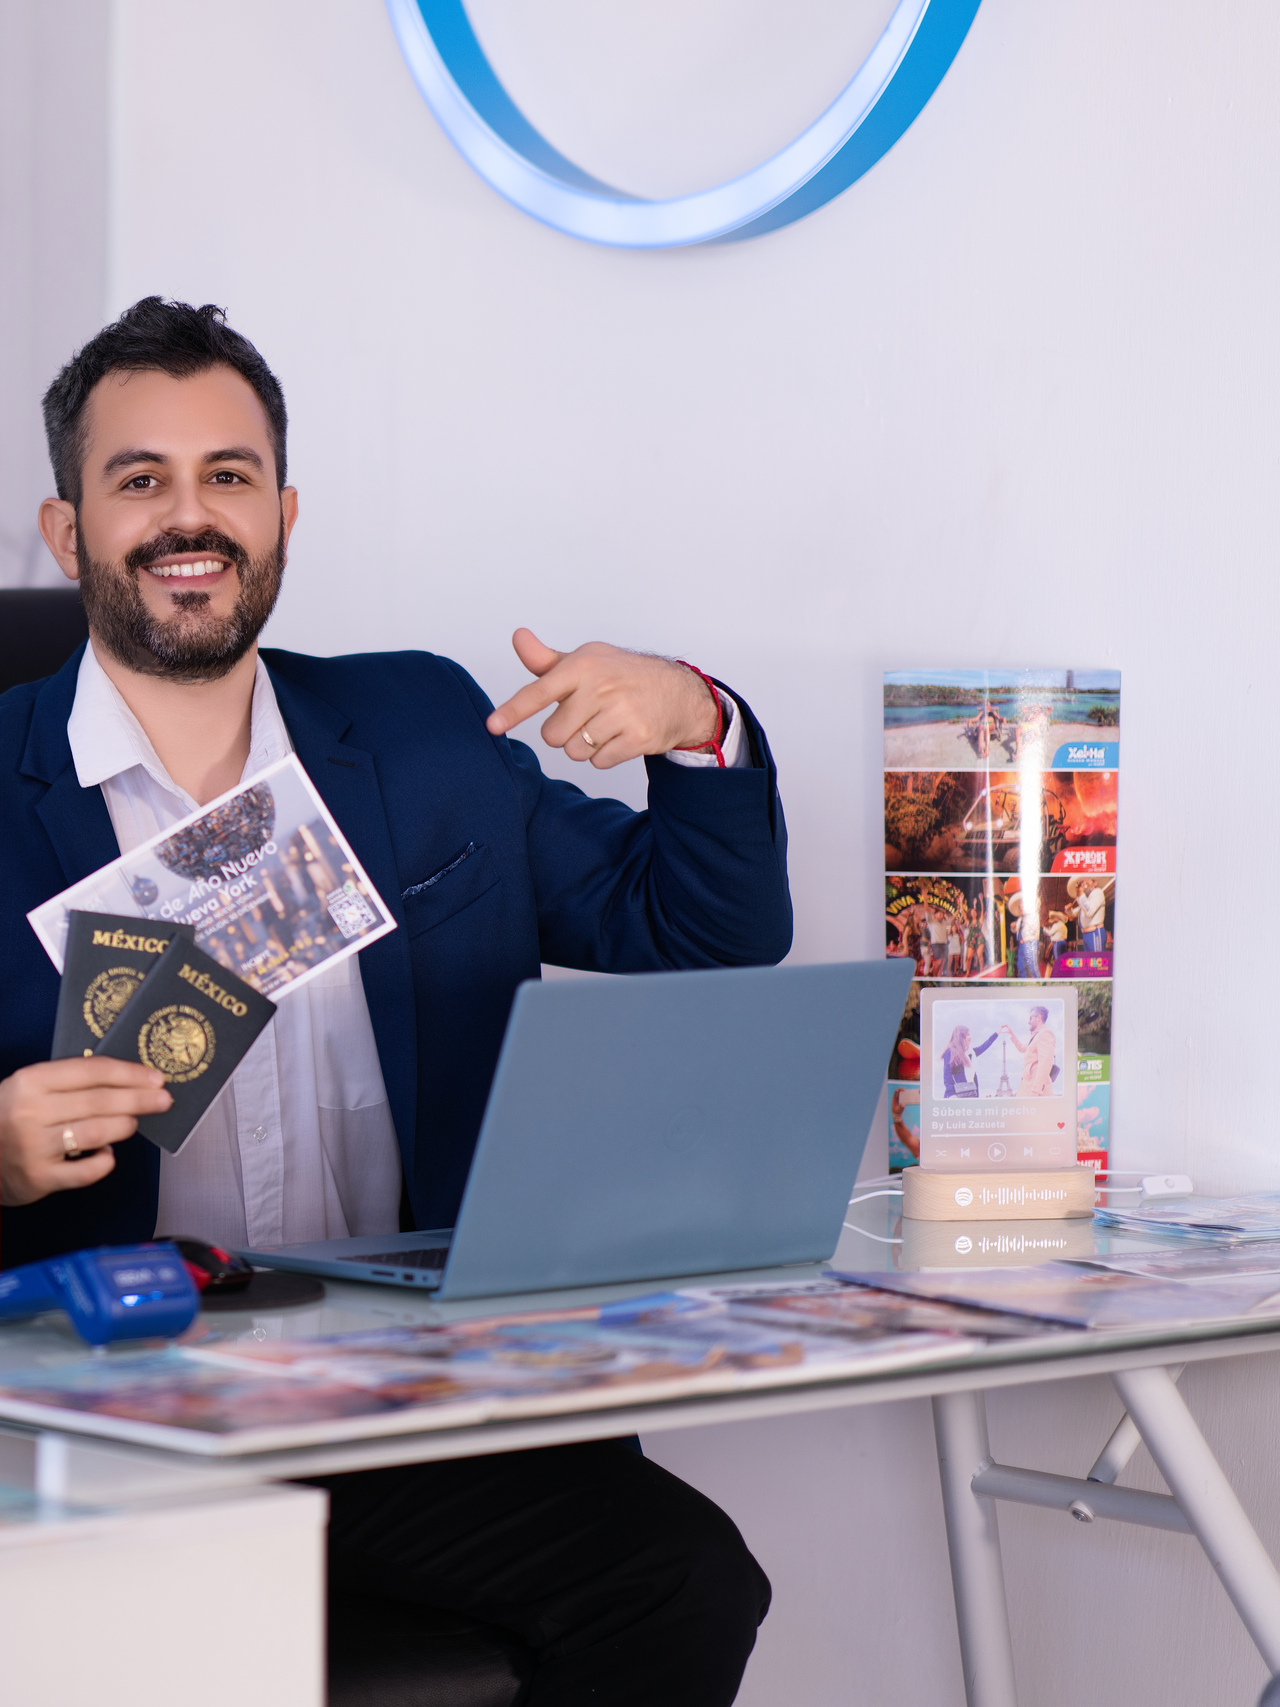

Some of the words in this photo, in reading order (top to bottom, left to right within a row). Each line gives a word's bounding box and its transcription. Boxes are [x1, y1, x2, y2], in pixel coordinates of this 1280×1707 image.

[160, 897, 185, 919] de
[188, 875, 223, 904] Año
[220, 841, 278, 881] Nuevo
[217, 872, 258, 900] York
[886, 895, 916, 914] VIVA
[177, 963, 248, 1017] MÉXICO
[932, 1106, 973, 1117] Súbete
[975, 1108, 982, 1116] a
[984, 1106, 999, 1116] mi
[1001, 1105, 1037, 1117] pecho
[931, 1121, 944, 1131] By
[946, 1121, 967, 1130] Luis
[968, 1120, 1006, 1129] Zazueta
